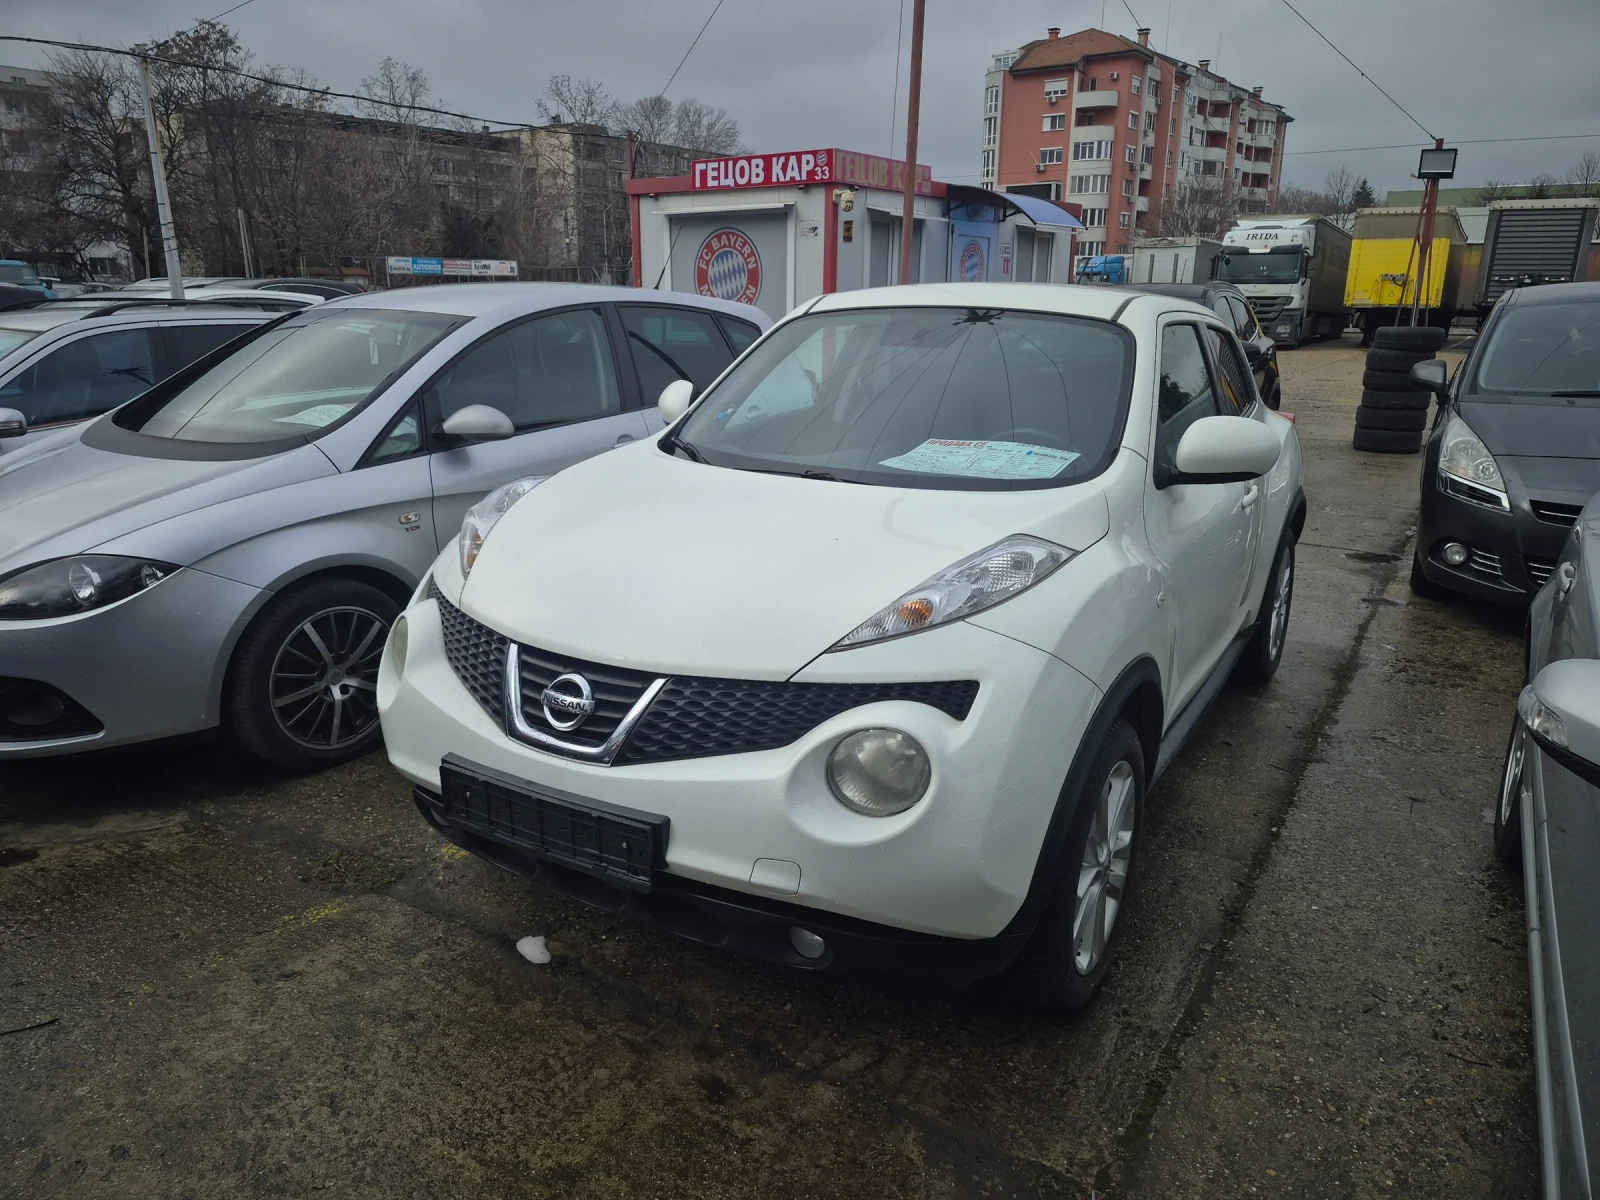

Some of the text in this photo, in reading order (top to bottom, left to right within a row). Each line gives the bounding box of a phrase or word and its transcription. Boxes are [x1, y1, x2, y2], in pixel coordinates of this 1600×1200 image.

[695, 153, 830, 188] ГЕЦОВ КАР 33
[836, 151, 889, 187] ГЕЦОВ
[892, 162, 923, 192] КР
[1246, 232, 1279, 241] IRIDA
[699, 234, 757, 270] FC BAYERN
[404, 524, 421, 533] TDI
[543, 693, 586, 713] NISSAN
